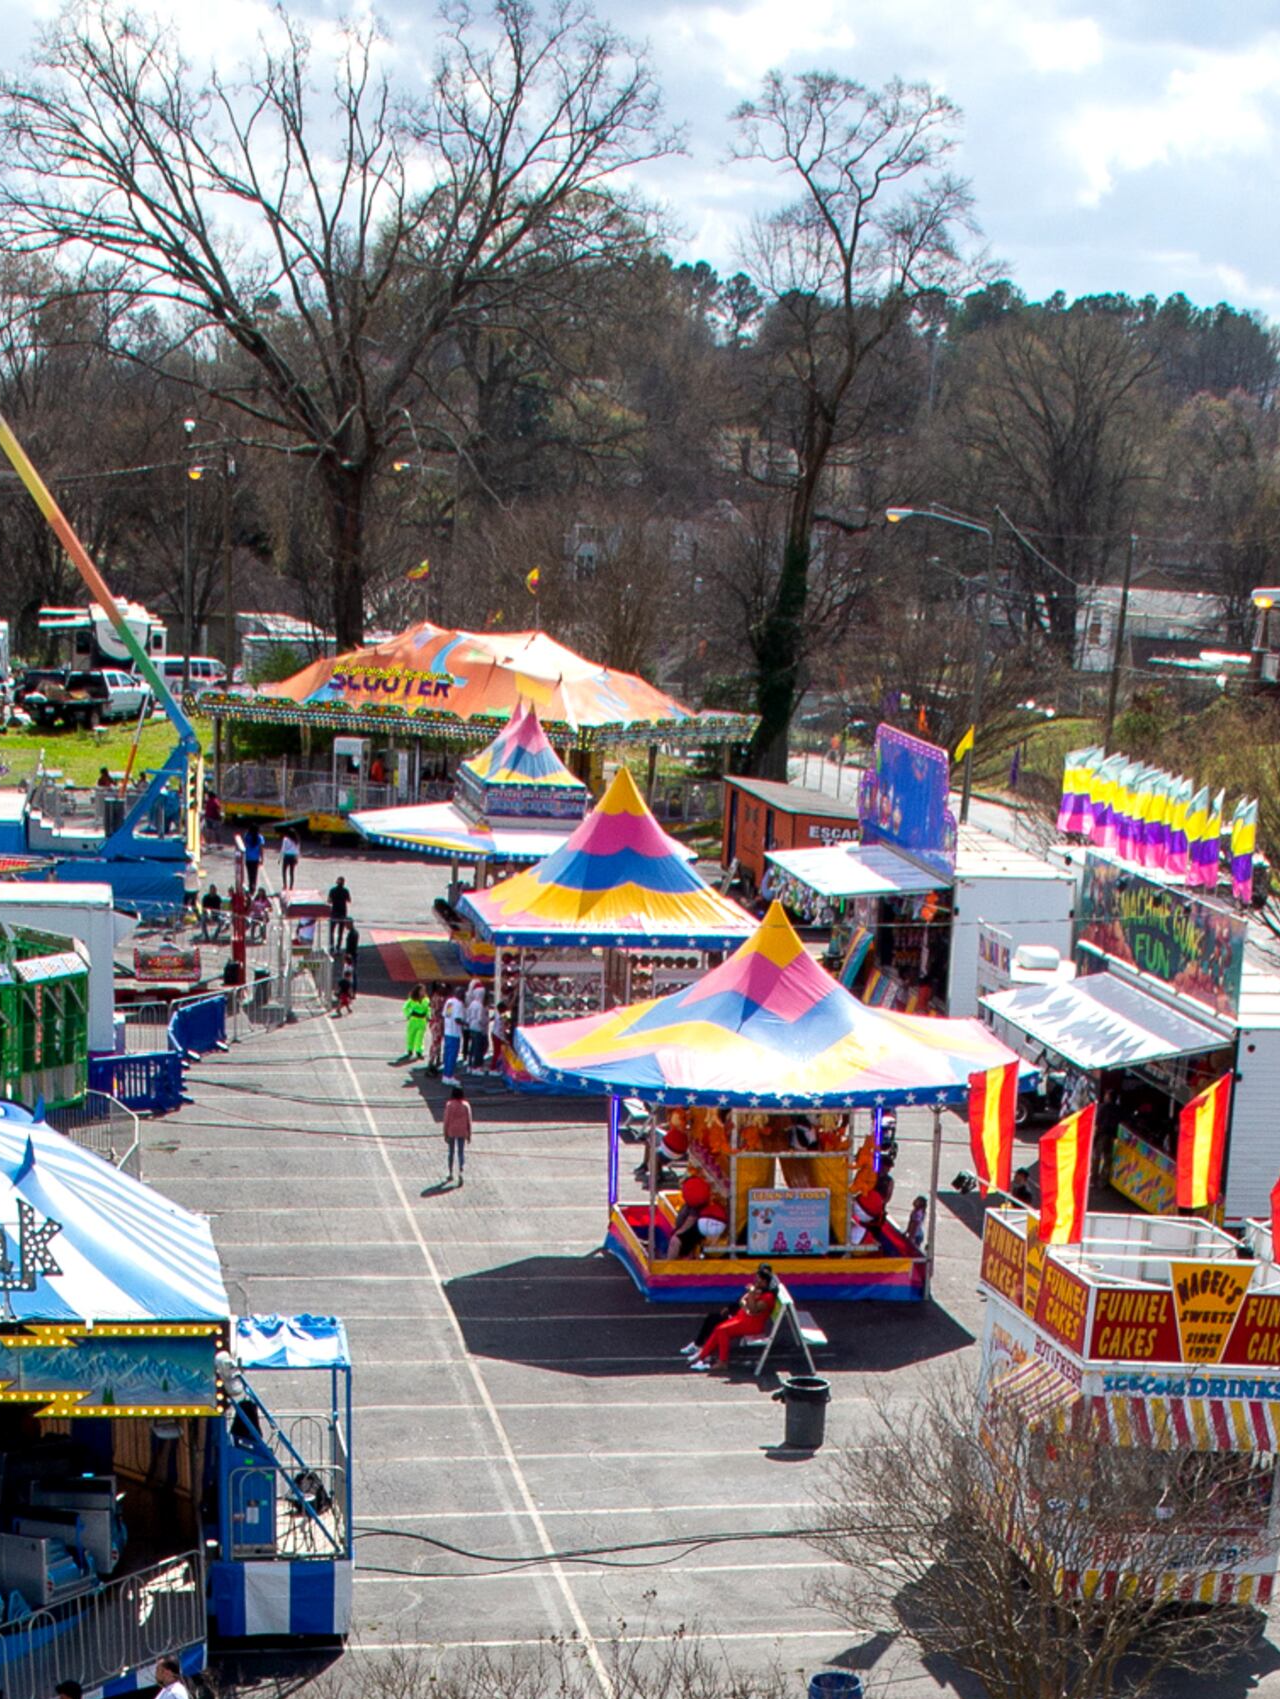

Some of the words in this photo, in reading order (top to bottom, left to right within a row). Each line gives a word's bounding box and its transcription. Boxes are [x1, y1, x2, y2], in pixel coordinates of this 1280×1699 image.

[328, 672, 453, 698] SCOOTER
[809, 825, 859, 840] ESCAP
[1135, 932, 1170, 979] FUN
[986, 1217, 1026, 1270] FUNNEL
[985, 1254, 1019, 1298] CAKES
[1046, 1265, 1087, 1317] FUNNEL
[1177, 1269, 1244, 1306] NAGEL'S
[1045, 1297, 1081, 1341] CAKES
[1096, 1292, 1168, 1324] FUNNEL
[1179, 1311, 1237, 1324] SWEETS
[1098, 1327, 1158, 1359] CAKES
[1185, 1332, 1222, 1345] SINCE
